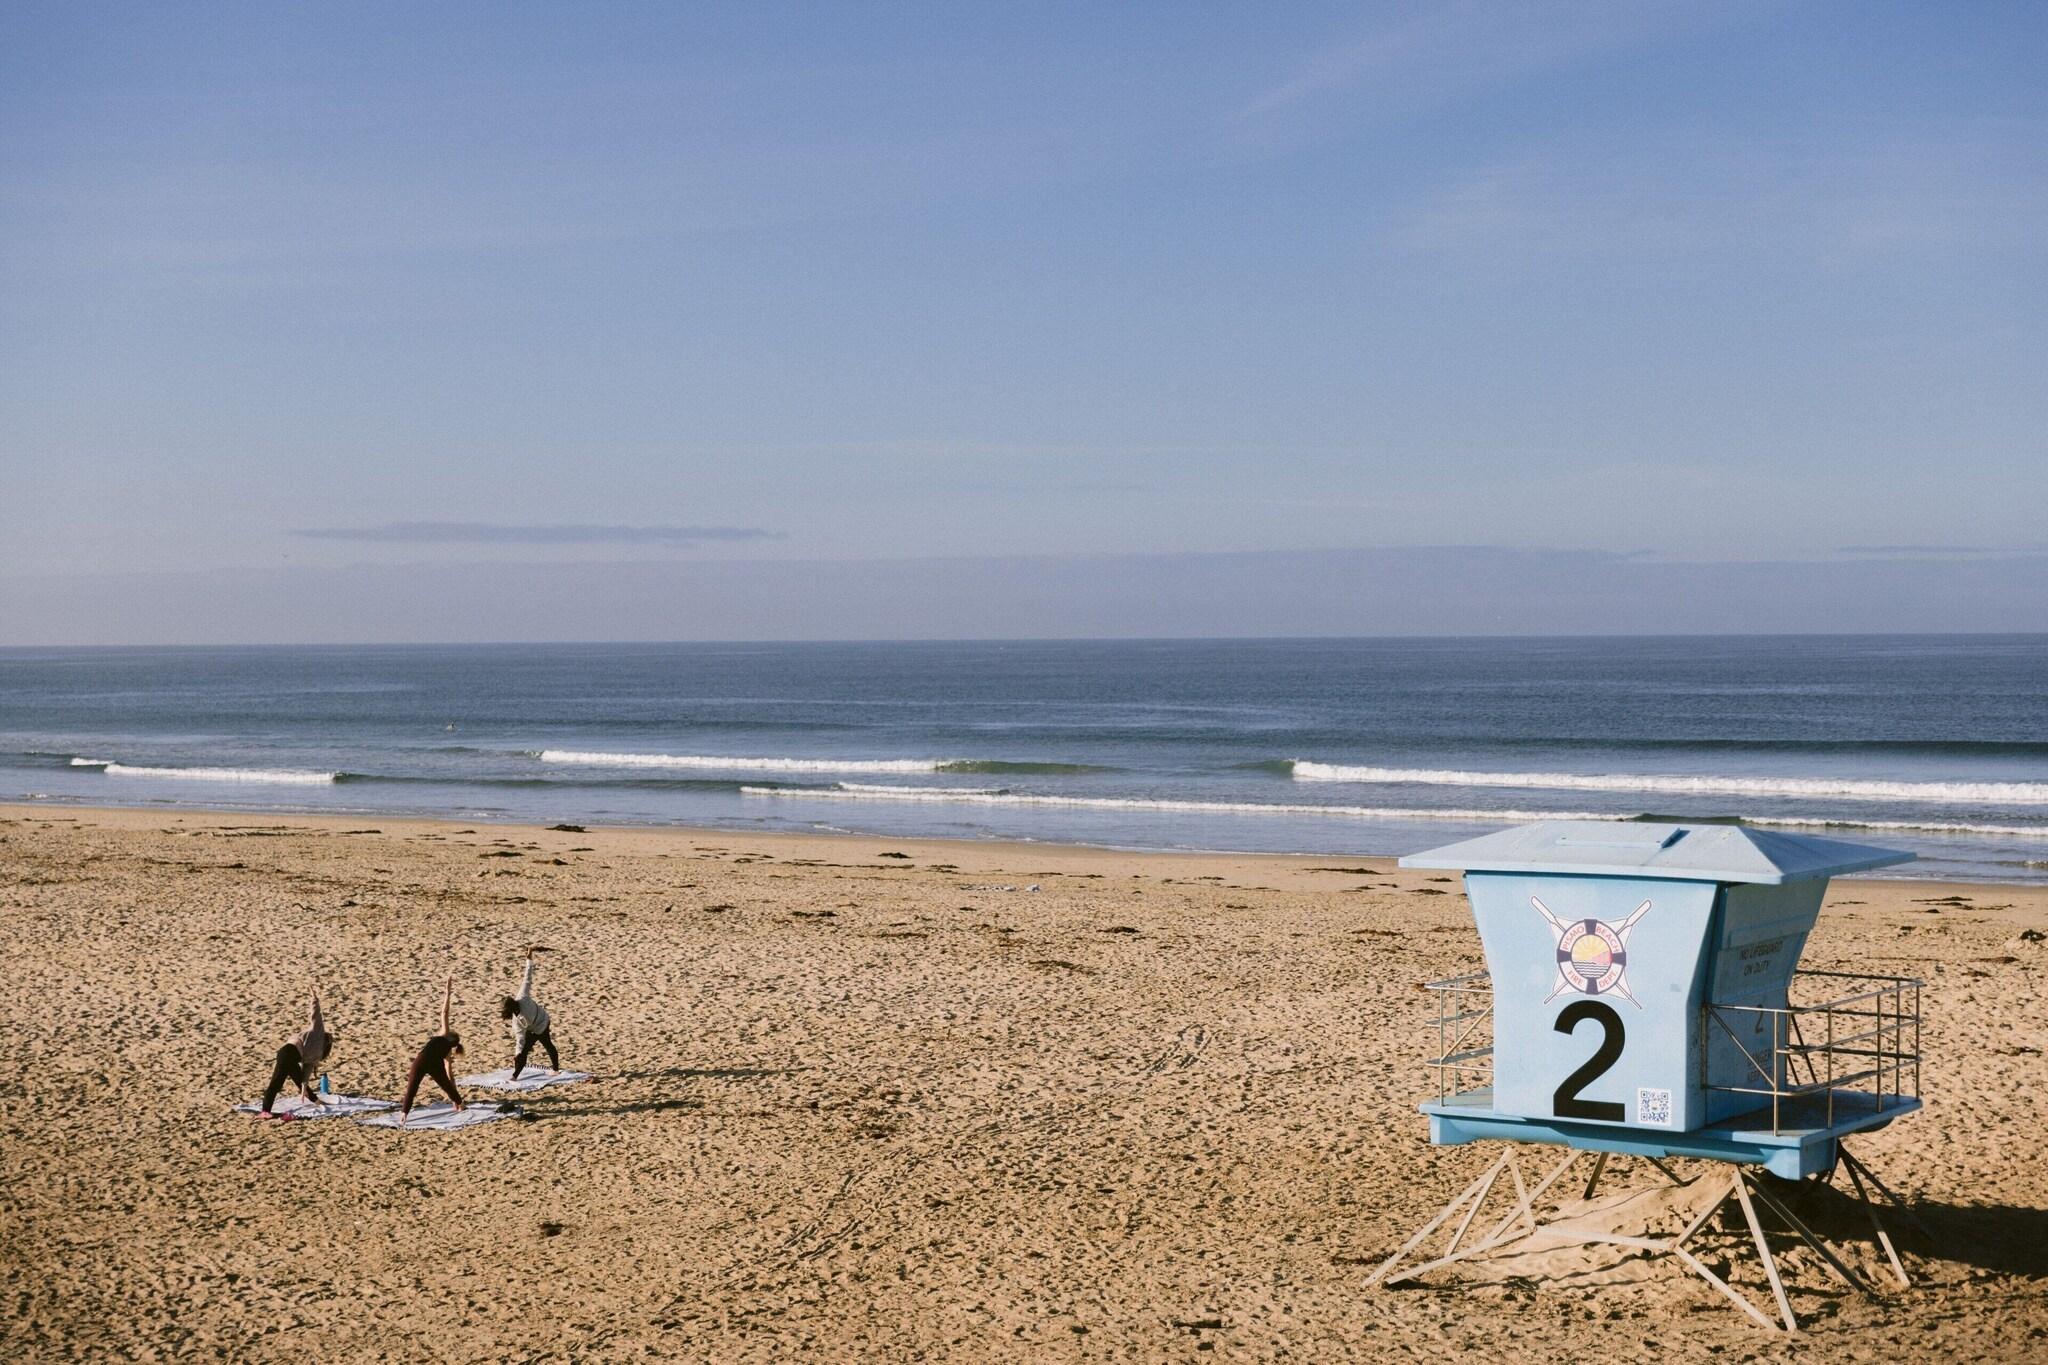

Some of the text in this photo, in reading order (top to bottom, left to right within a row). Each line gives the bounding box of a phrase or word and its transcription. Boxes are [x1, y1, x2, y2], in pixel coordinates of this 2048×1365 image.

[1561, 926, 1621, 953] PISMO BEACH
[1567, 970, 1585, 986] FIRE
[1755, 1003, 1764, 1034] 2
[1553, 999, 1626, 1122] 2
